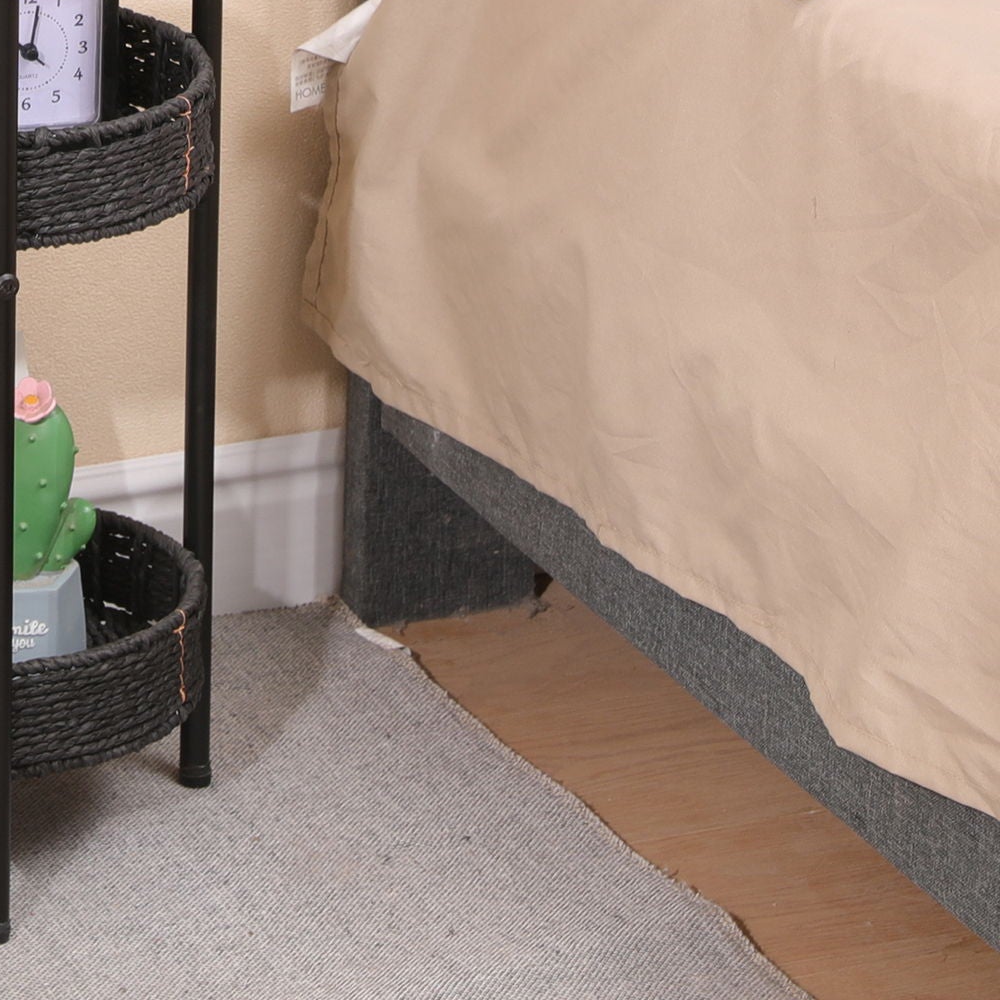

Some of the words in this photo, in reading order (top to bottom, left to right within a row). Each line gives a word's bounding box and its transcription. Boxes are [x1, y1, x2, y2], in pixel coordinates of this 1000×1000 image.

[73, 13, 84, 27] 2
[77, 40, 88, 55] 3
[72, 66, 83, 81] 4
[21, 96, 32, 111] 6
[50, 89, 61, 104] 5
[12, 619, 49, 635] mile
